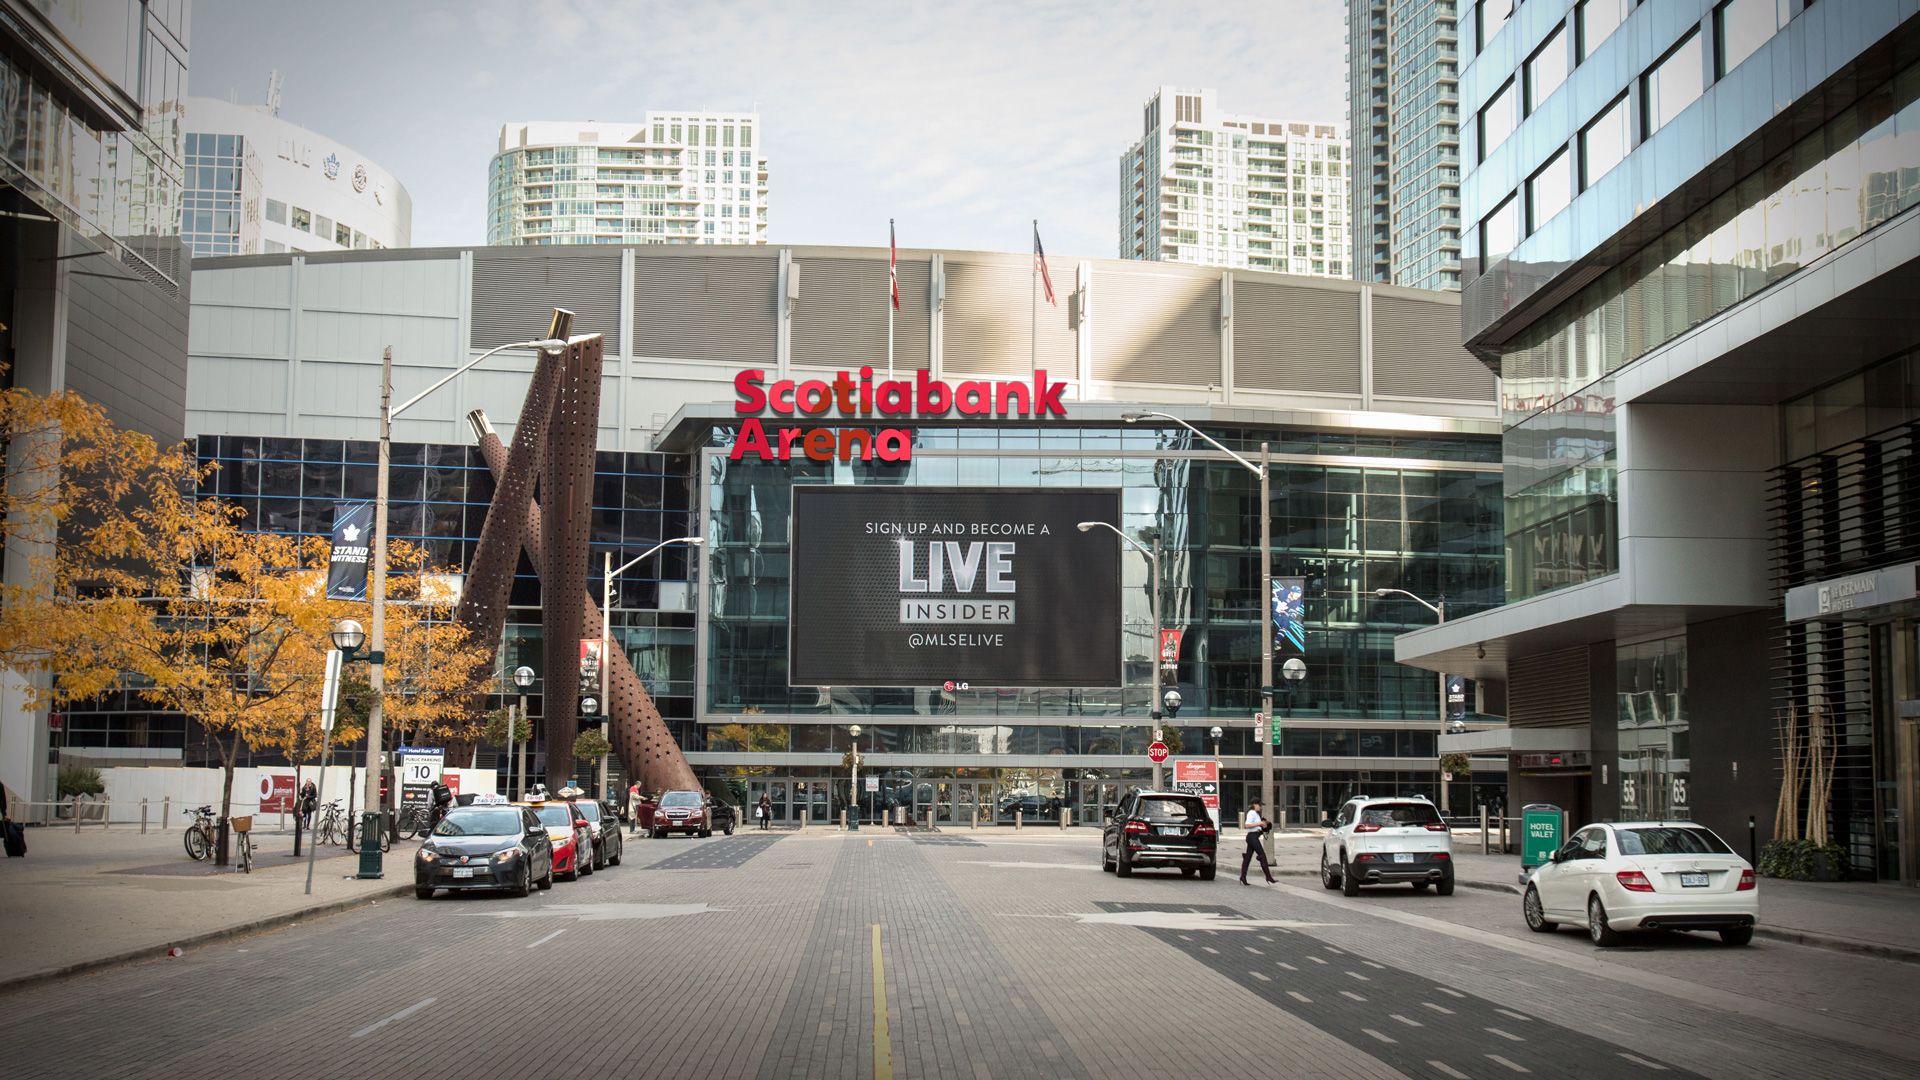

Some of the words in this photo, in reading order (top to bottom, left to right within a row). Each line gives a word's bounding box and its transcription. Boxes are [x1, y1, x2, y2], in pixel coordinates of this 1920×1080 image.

[734, 366, 1068, 414] Scotiabank
[729, 417, 912, 461] Arena
[865, 522, 901, 534] SIGN
[907, 523, 928, 534] UP
[931, 523, 965, 535] AND
[971, 523, 1035, 535] BECOME
[1040, 524, 1051, 535] A
[333, 546, 368, 556] STAND
[331, 554, 367, 563] WITNESS
[899, 541, 1016, 593] LIVE
[907, 603, 1010, 620] INSIDER
[908, 633, 1004, 649] @MLSELIVE
[956, 682, 969, 690] LG
[1149, 748, 1168, 757] STOP
[1623, 779, 1636, 803] 55
[1672, 779, 1686, 803] 65
[1530, 823, 1555, 831] HOTEL
[1530, 830, 1554, 838] VALET
